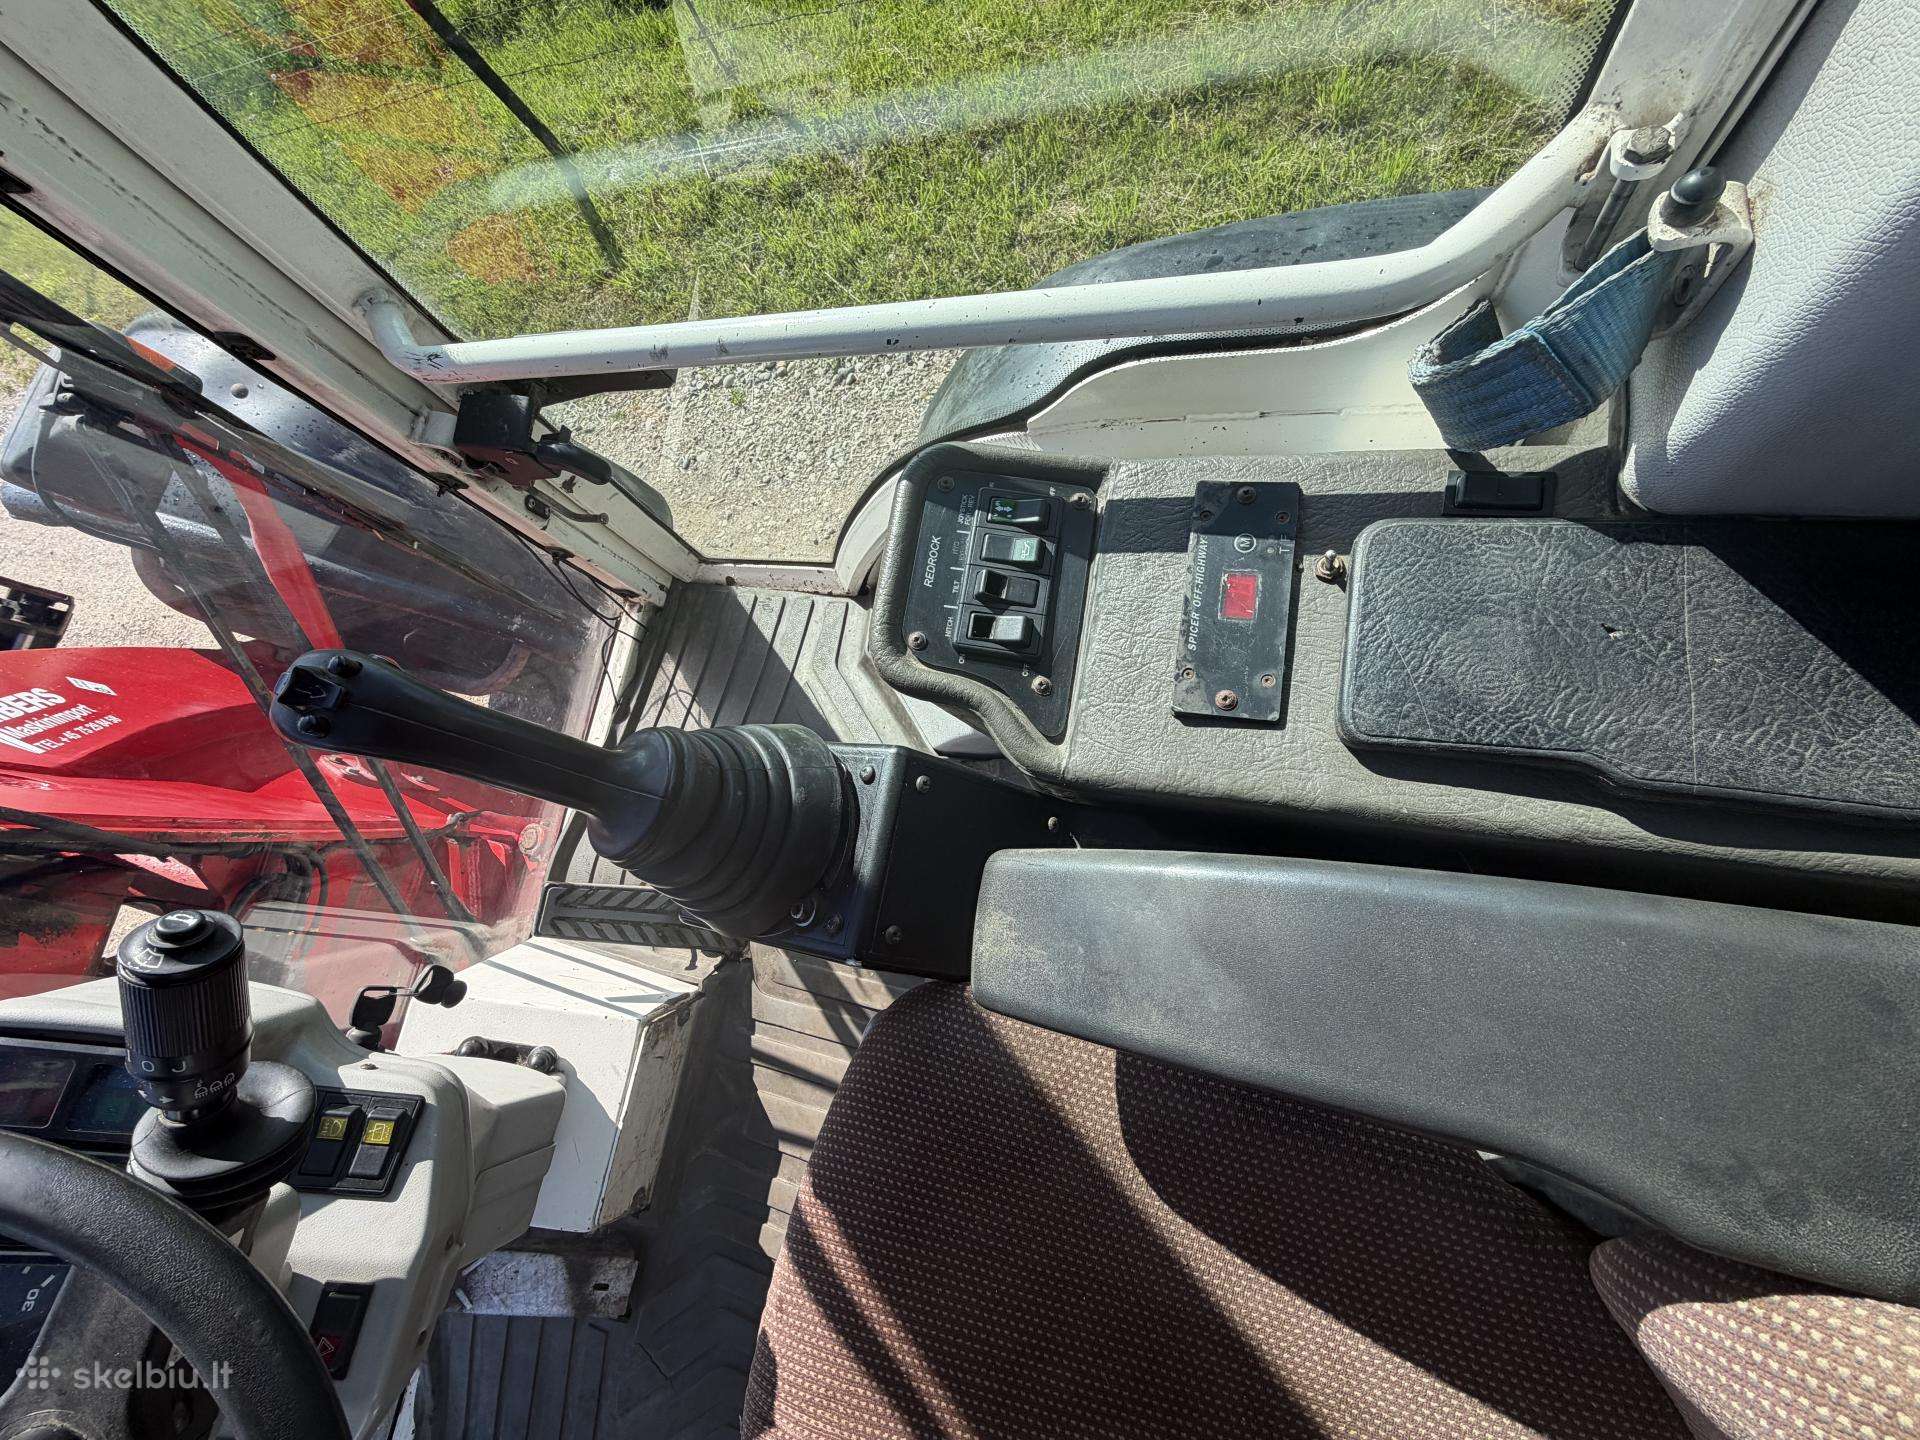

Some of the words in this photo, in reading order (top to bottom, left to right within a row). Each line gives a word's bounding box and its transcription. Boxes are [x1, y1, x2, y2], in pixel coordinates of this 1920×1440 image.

[923, 535, 942, 588] REDROCK
[1192, 539, 1209, 608] OFF-HIGHWAY
[951, 580, 960, 593] TILT
[944, 616, 954, 638] HITCH
[1187, 613, 1200, 652] SPICER
[0, 703, 98, 739] Maskinimport
[21, 1288, 40, 1312] 30
